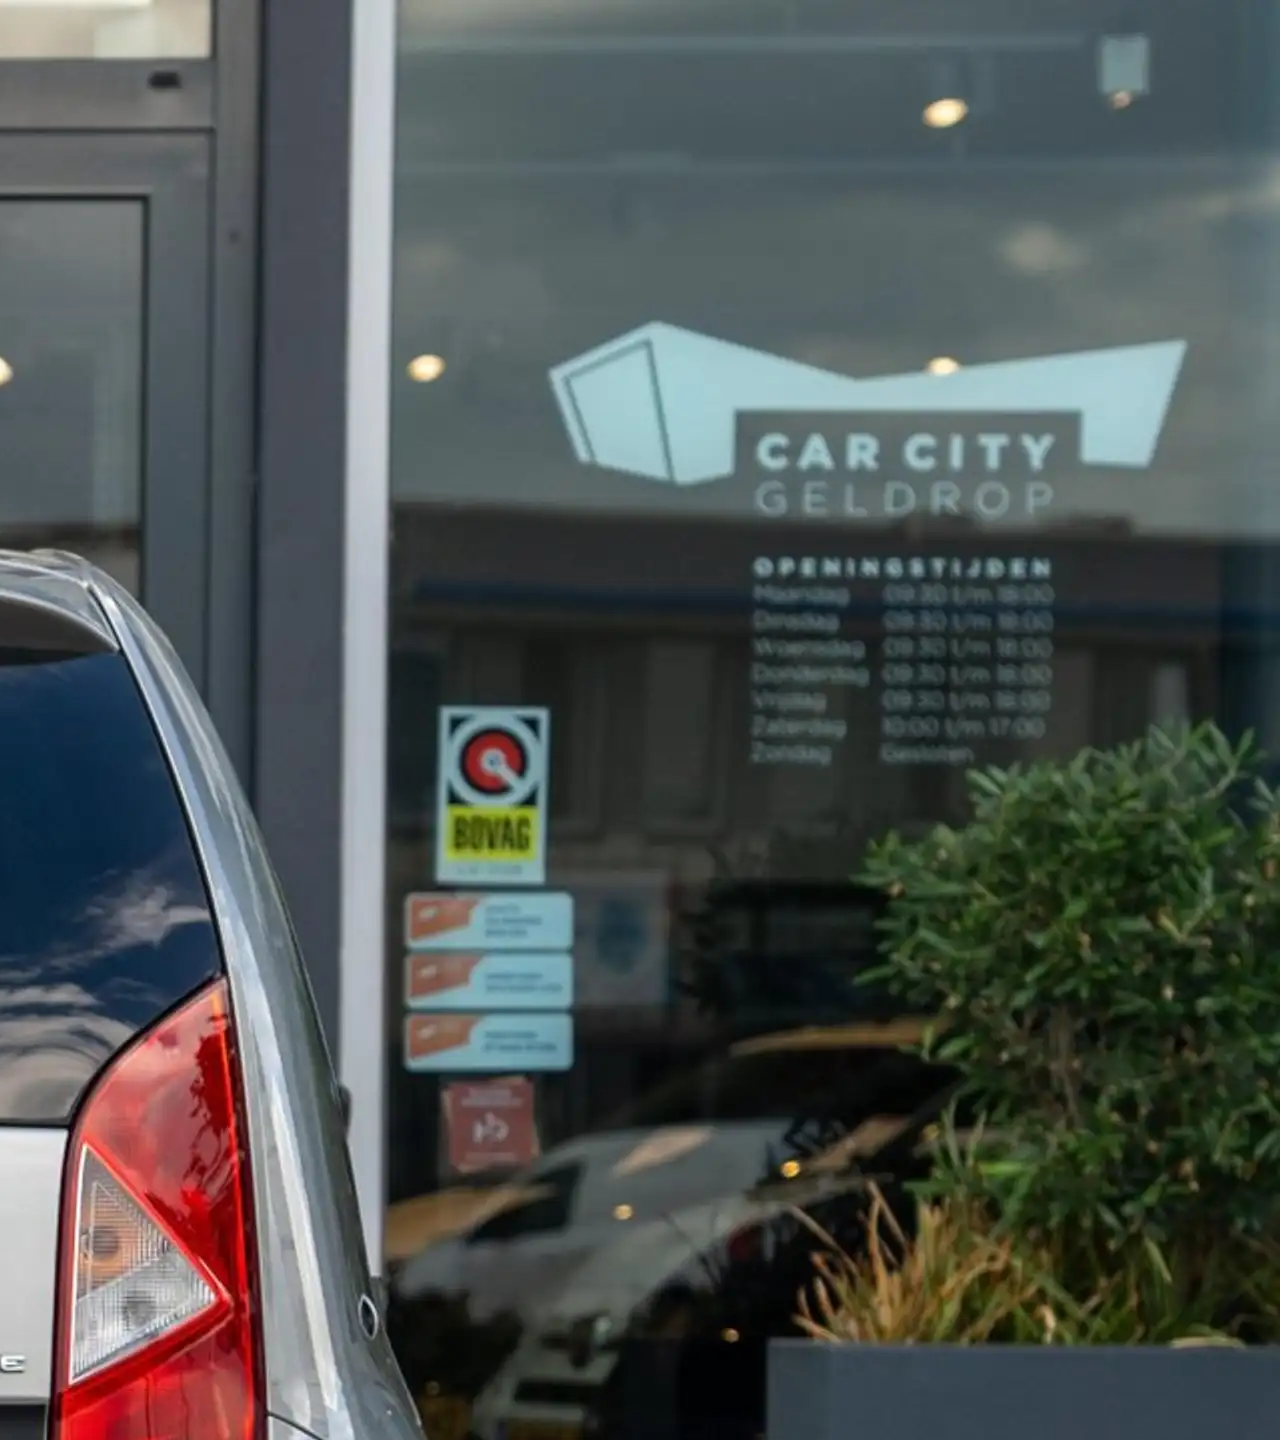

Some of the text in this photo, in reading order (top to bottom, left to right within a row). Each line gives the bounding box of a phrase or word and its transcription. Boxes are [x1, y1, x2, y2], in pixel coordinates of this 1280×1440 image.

[755, 432, 1056, 472] CAR CITY
[755, 480, 1055, 520] GELDROP
[752, 556, 1052, 579] OPENINGSTIJDEN
[451, 815, 532, 853] BOVAG
